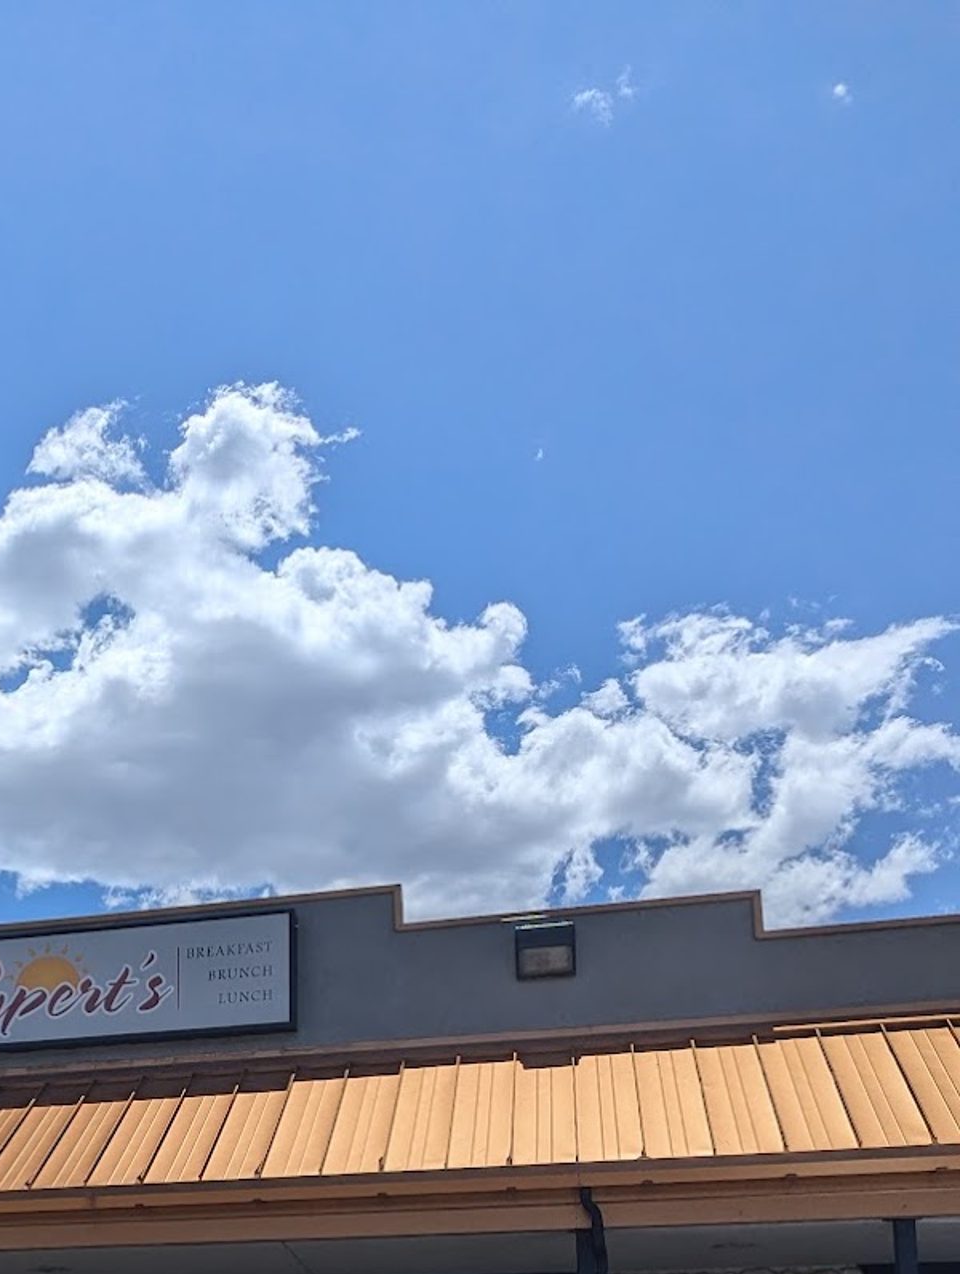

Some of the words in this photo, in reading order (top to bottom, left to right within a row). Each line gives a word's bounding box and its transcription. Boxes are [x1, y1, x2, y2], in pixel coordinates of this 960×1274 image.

[186, 941, 273, 960] BREAKFAST
[208, 965, 273, 981] BRUNCH
[218, 989, 273, 1005] LUNCH
